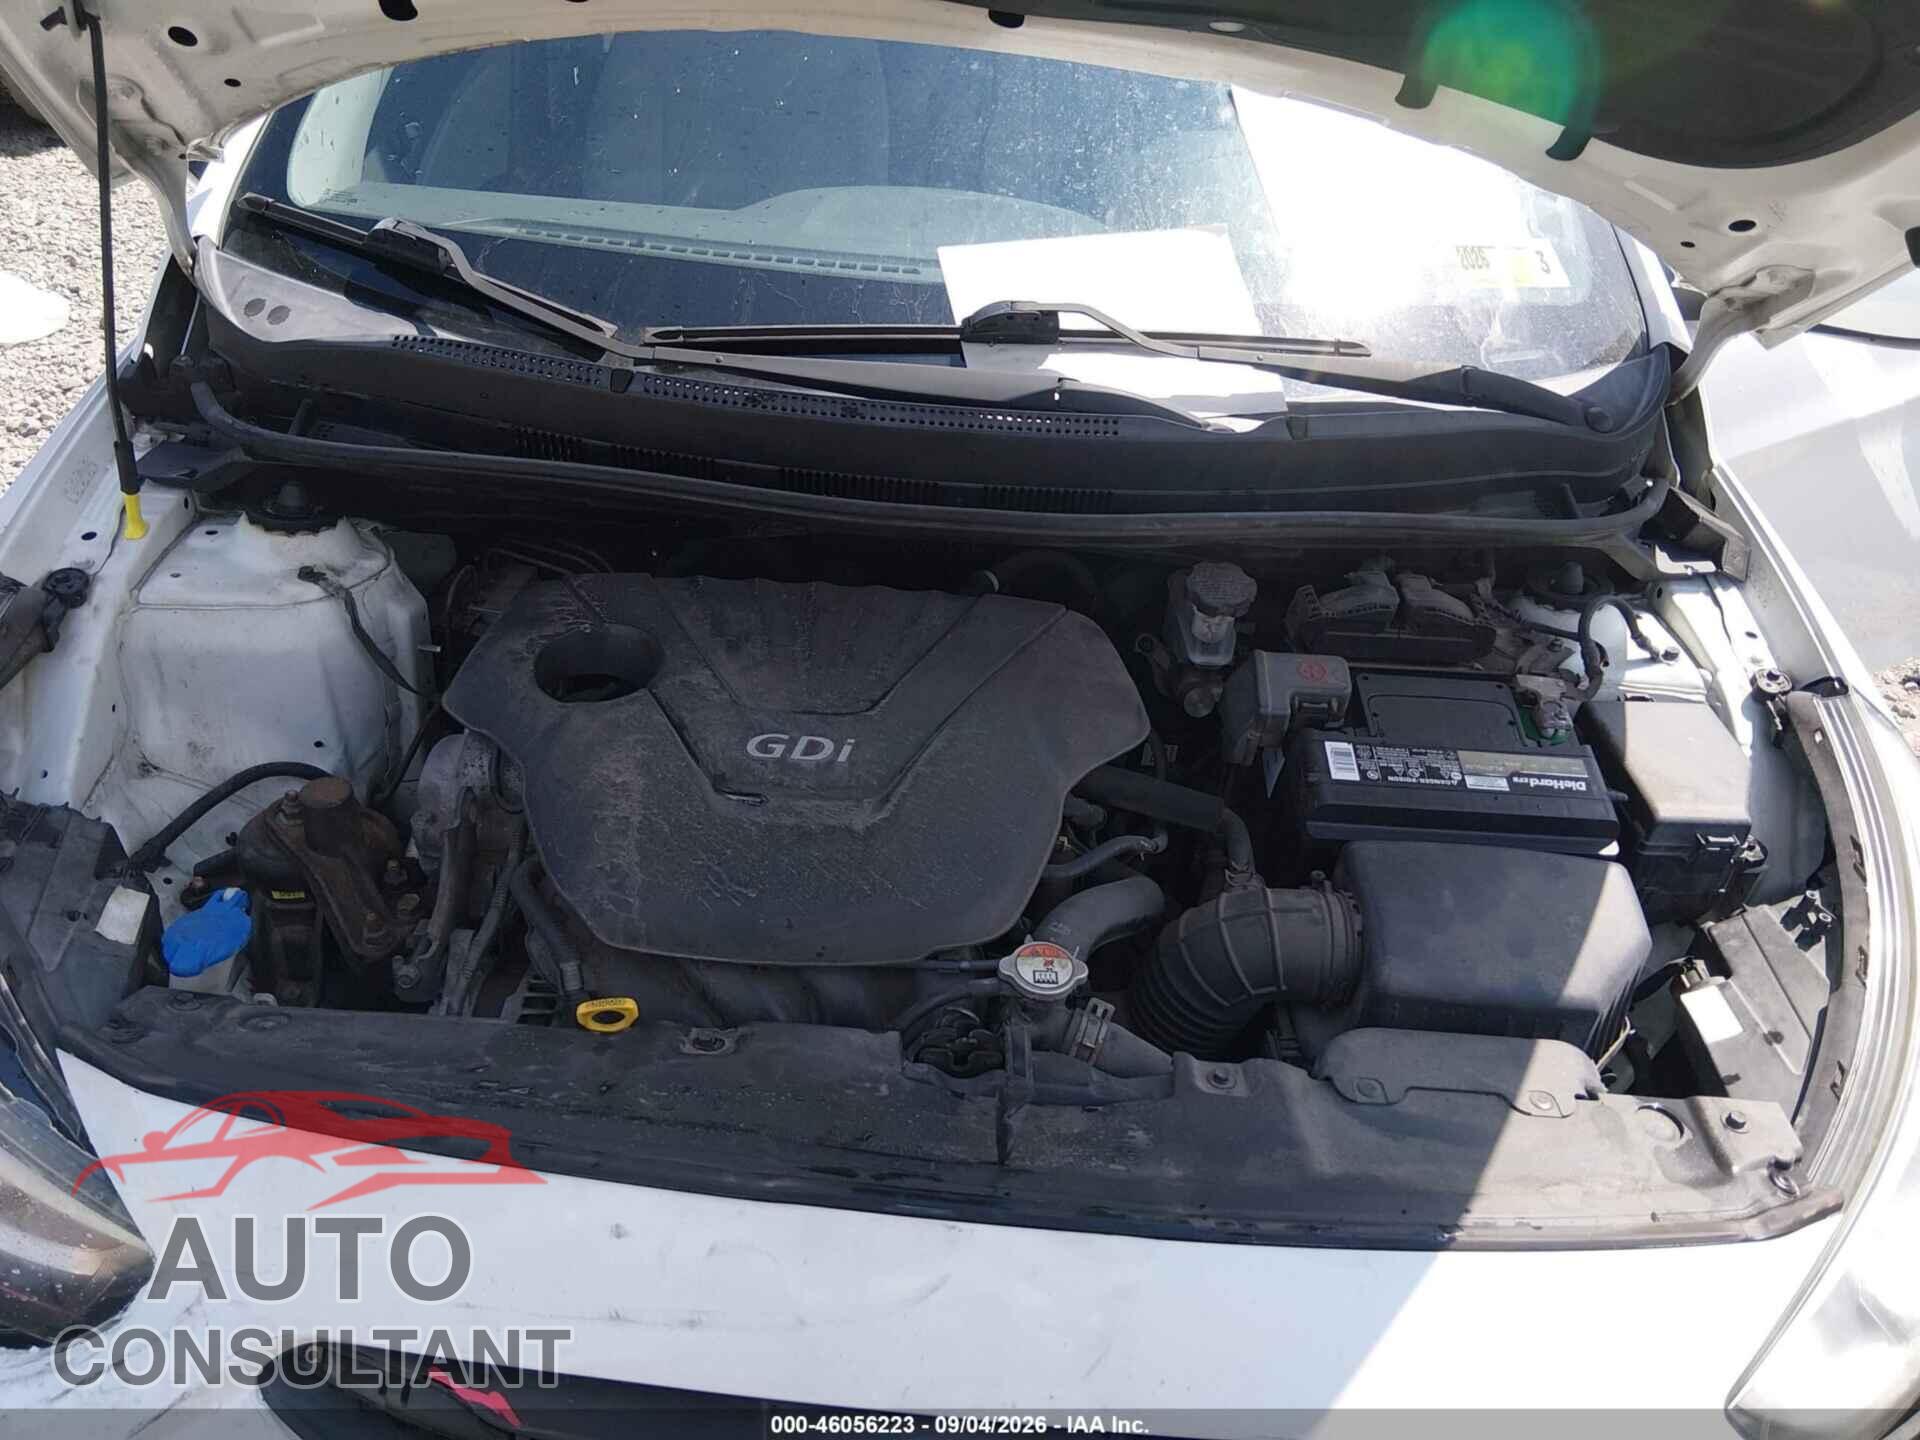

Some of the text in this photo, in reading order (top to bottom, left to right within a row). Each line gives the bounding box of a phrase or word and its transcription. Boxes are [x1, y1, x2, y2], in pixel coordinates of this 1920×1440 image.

[1535, 250, 1551, 274] 3
[746, 733, 855, 762] GDi
[1529, 777, 1587, 792] DieHard
